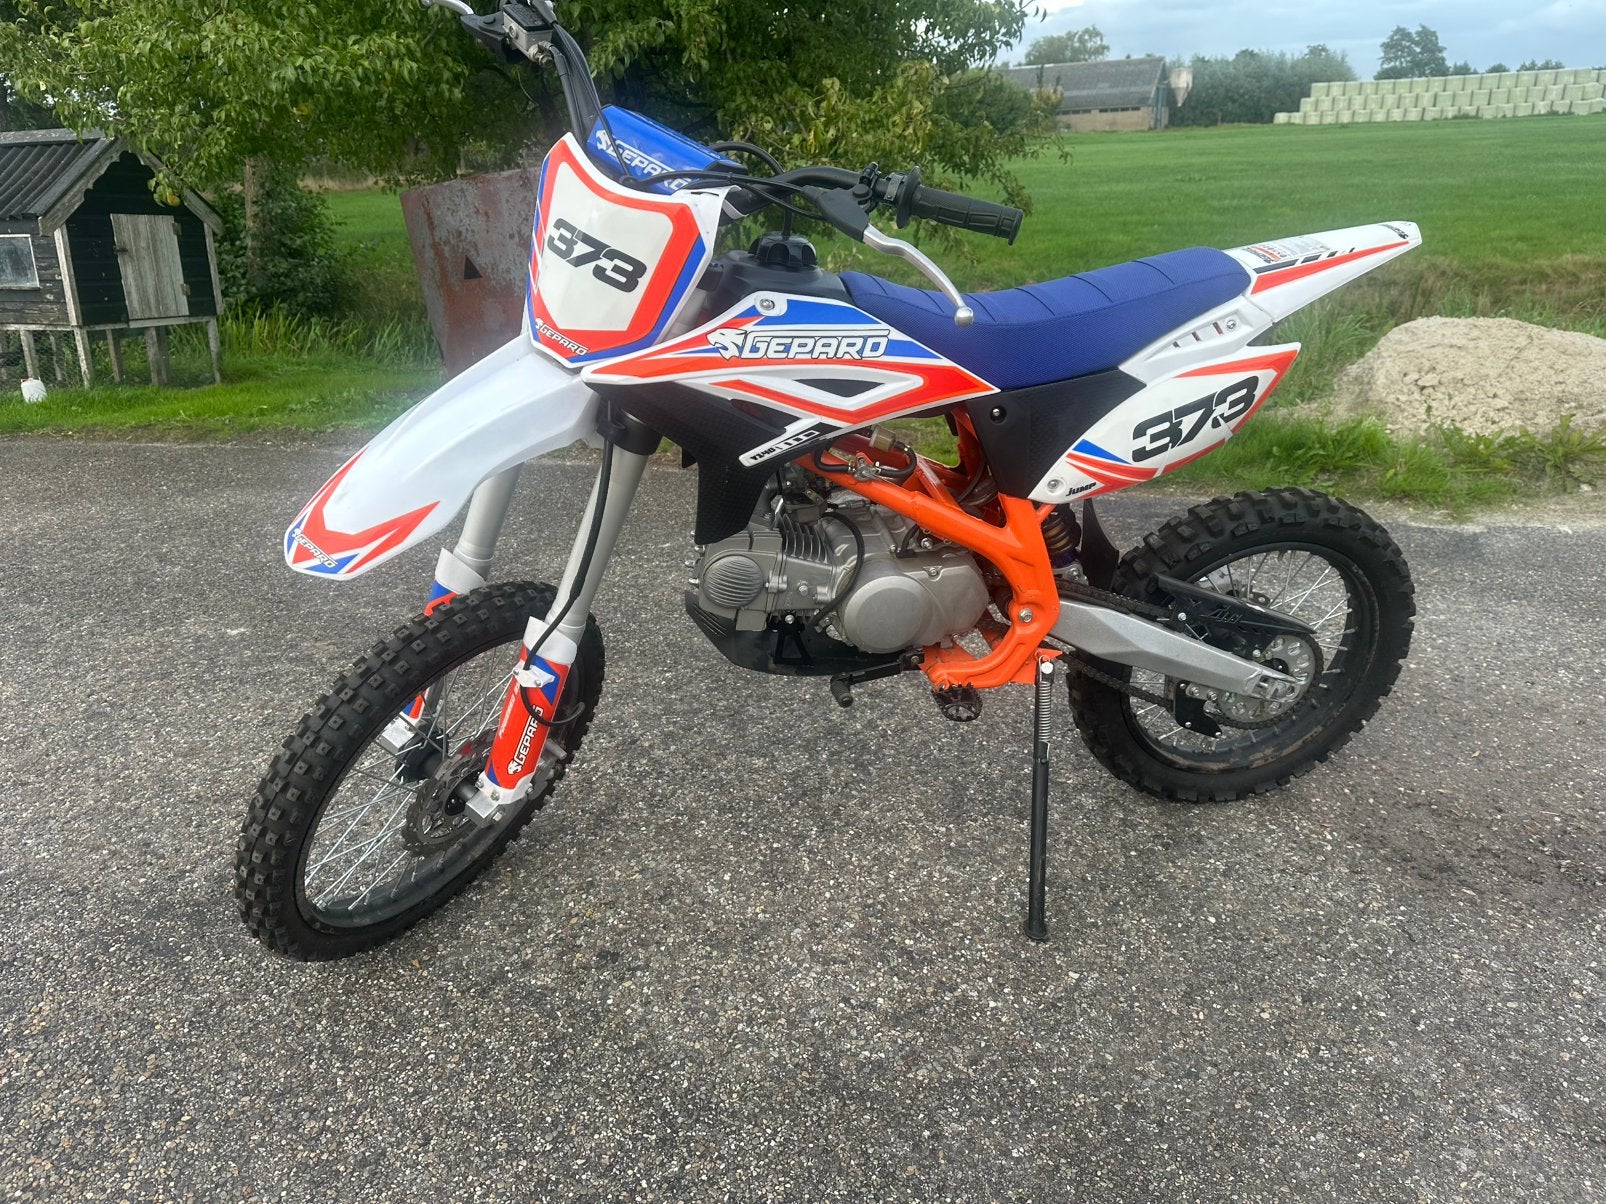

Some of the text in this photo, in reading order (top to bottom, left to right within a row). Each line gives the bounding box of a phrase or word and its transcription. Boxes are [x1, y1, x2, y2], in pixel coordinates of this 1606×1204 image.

[547, 217, 648, 293] 373
[540, 321, 589, 356] GEPARD
[740, 329, 891, 360] GEPARD
[1132, 375, 1260, 463] 373
[295, 533, 339, 568] GEPARD
